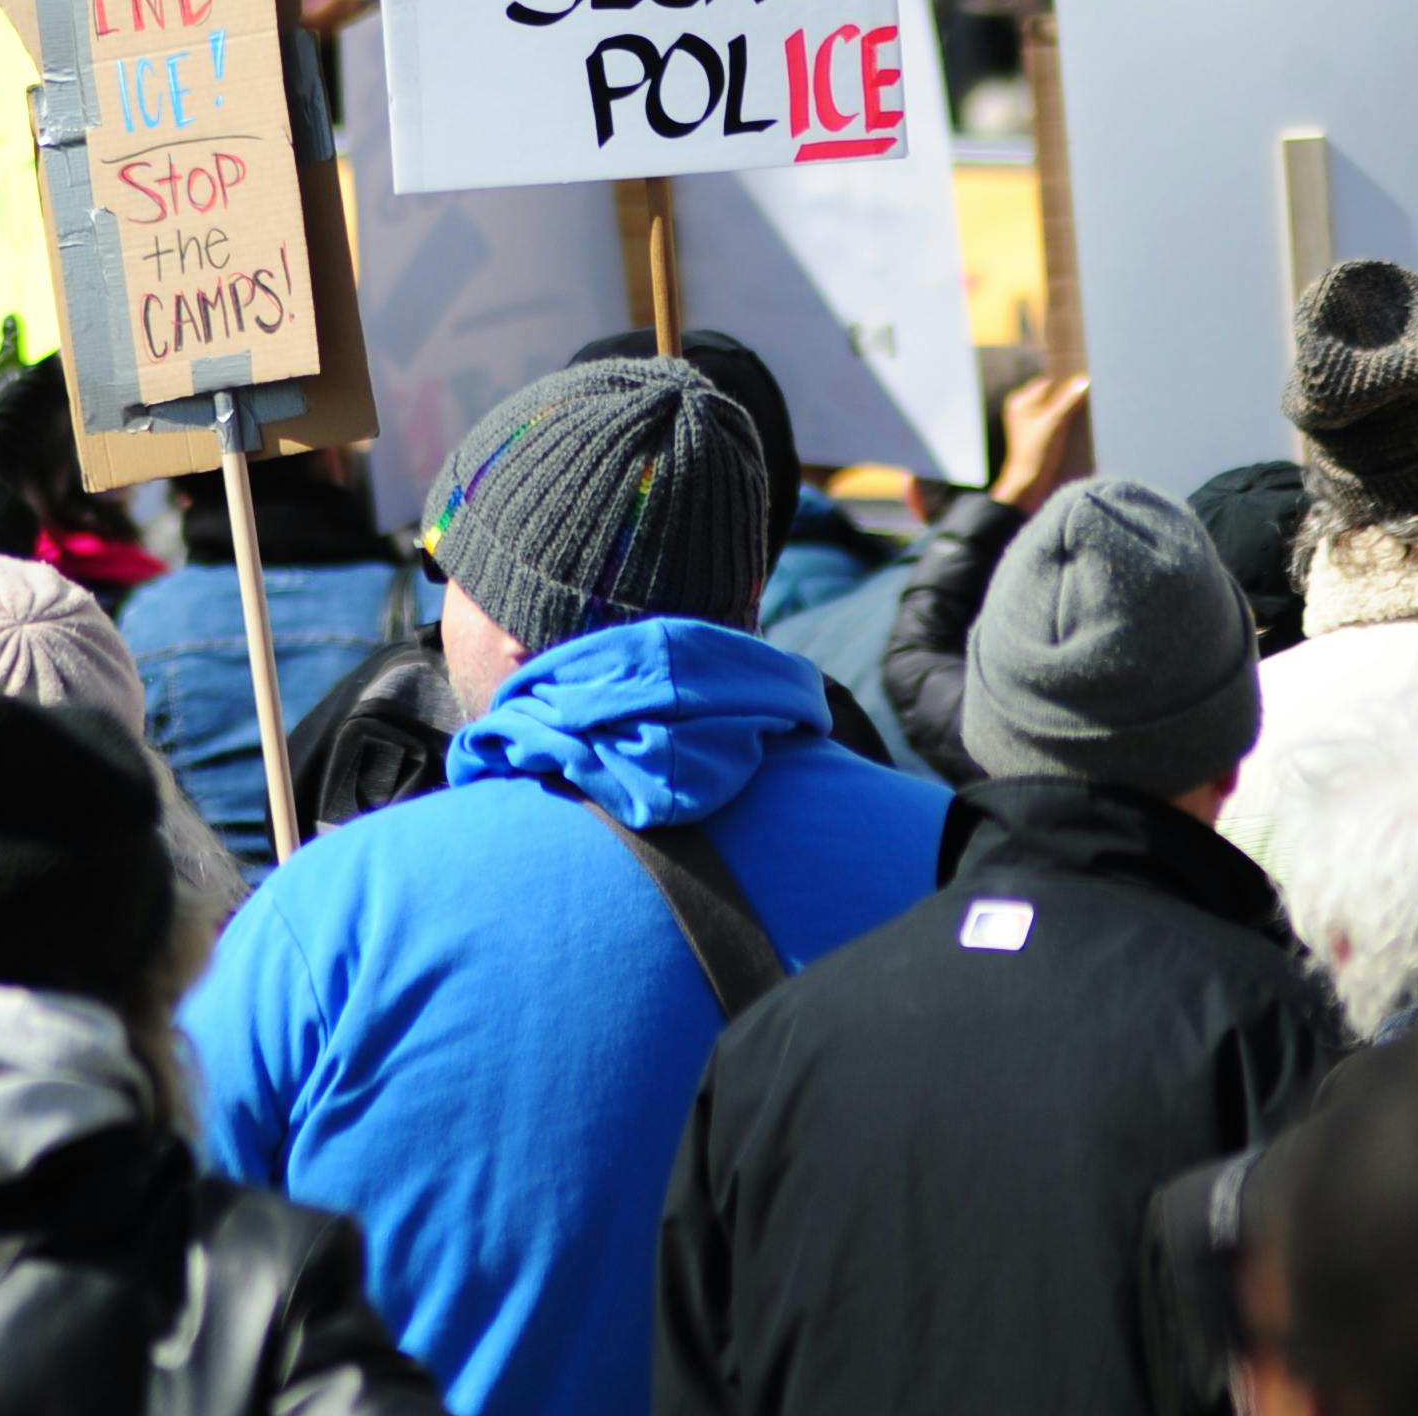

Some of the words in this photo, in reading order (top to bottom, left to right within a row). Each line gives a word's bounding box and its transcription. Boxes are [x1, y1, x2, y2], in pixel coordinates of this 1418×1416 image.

[116, 29, 226, 134] ICE!
[587, 24, 905, 150] POLICE
[140, 239, 296, 364] CAMPS!
[142, 227, 231, 282] the
